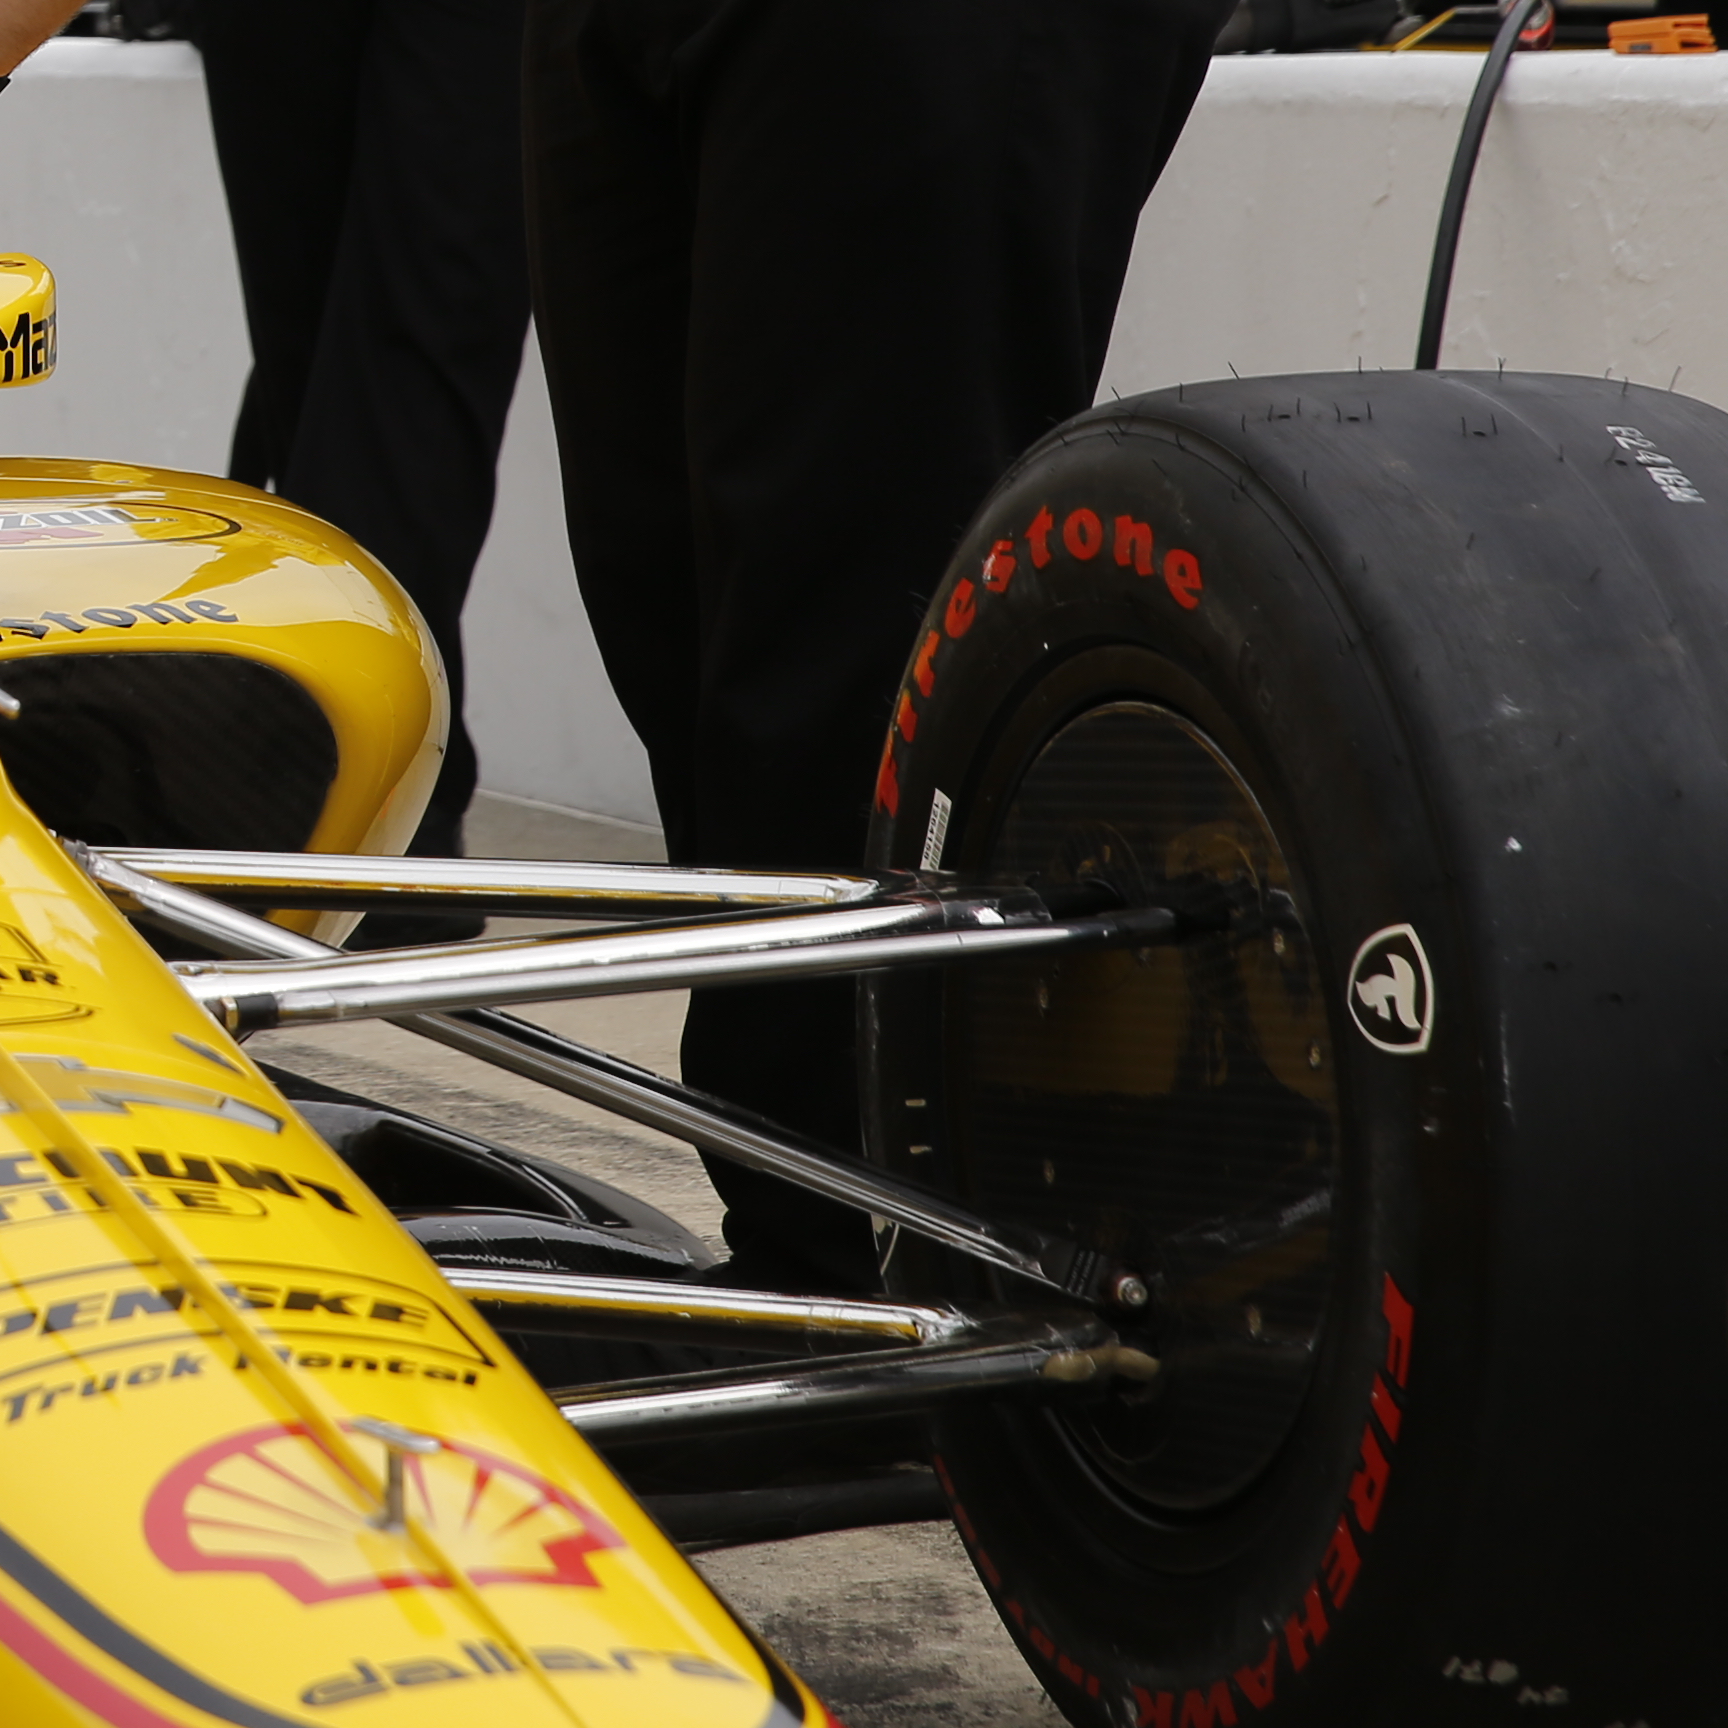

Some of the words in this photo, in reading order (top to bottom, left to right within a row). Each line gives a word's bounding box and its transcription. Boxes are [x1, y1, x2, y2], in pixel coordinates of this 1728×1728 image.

[874, 501, 1205, 819] Firestone
[1, 1351, 209, 1425] Truck
[1132, 1271, 1417, 1728] FIREHAWK
[299, 1638, 760, 1708] dallara
